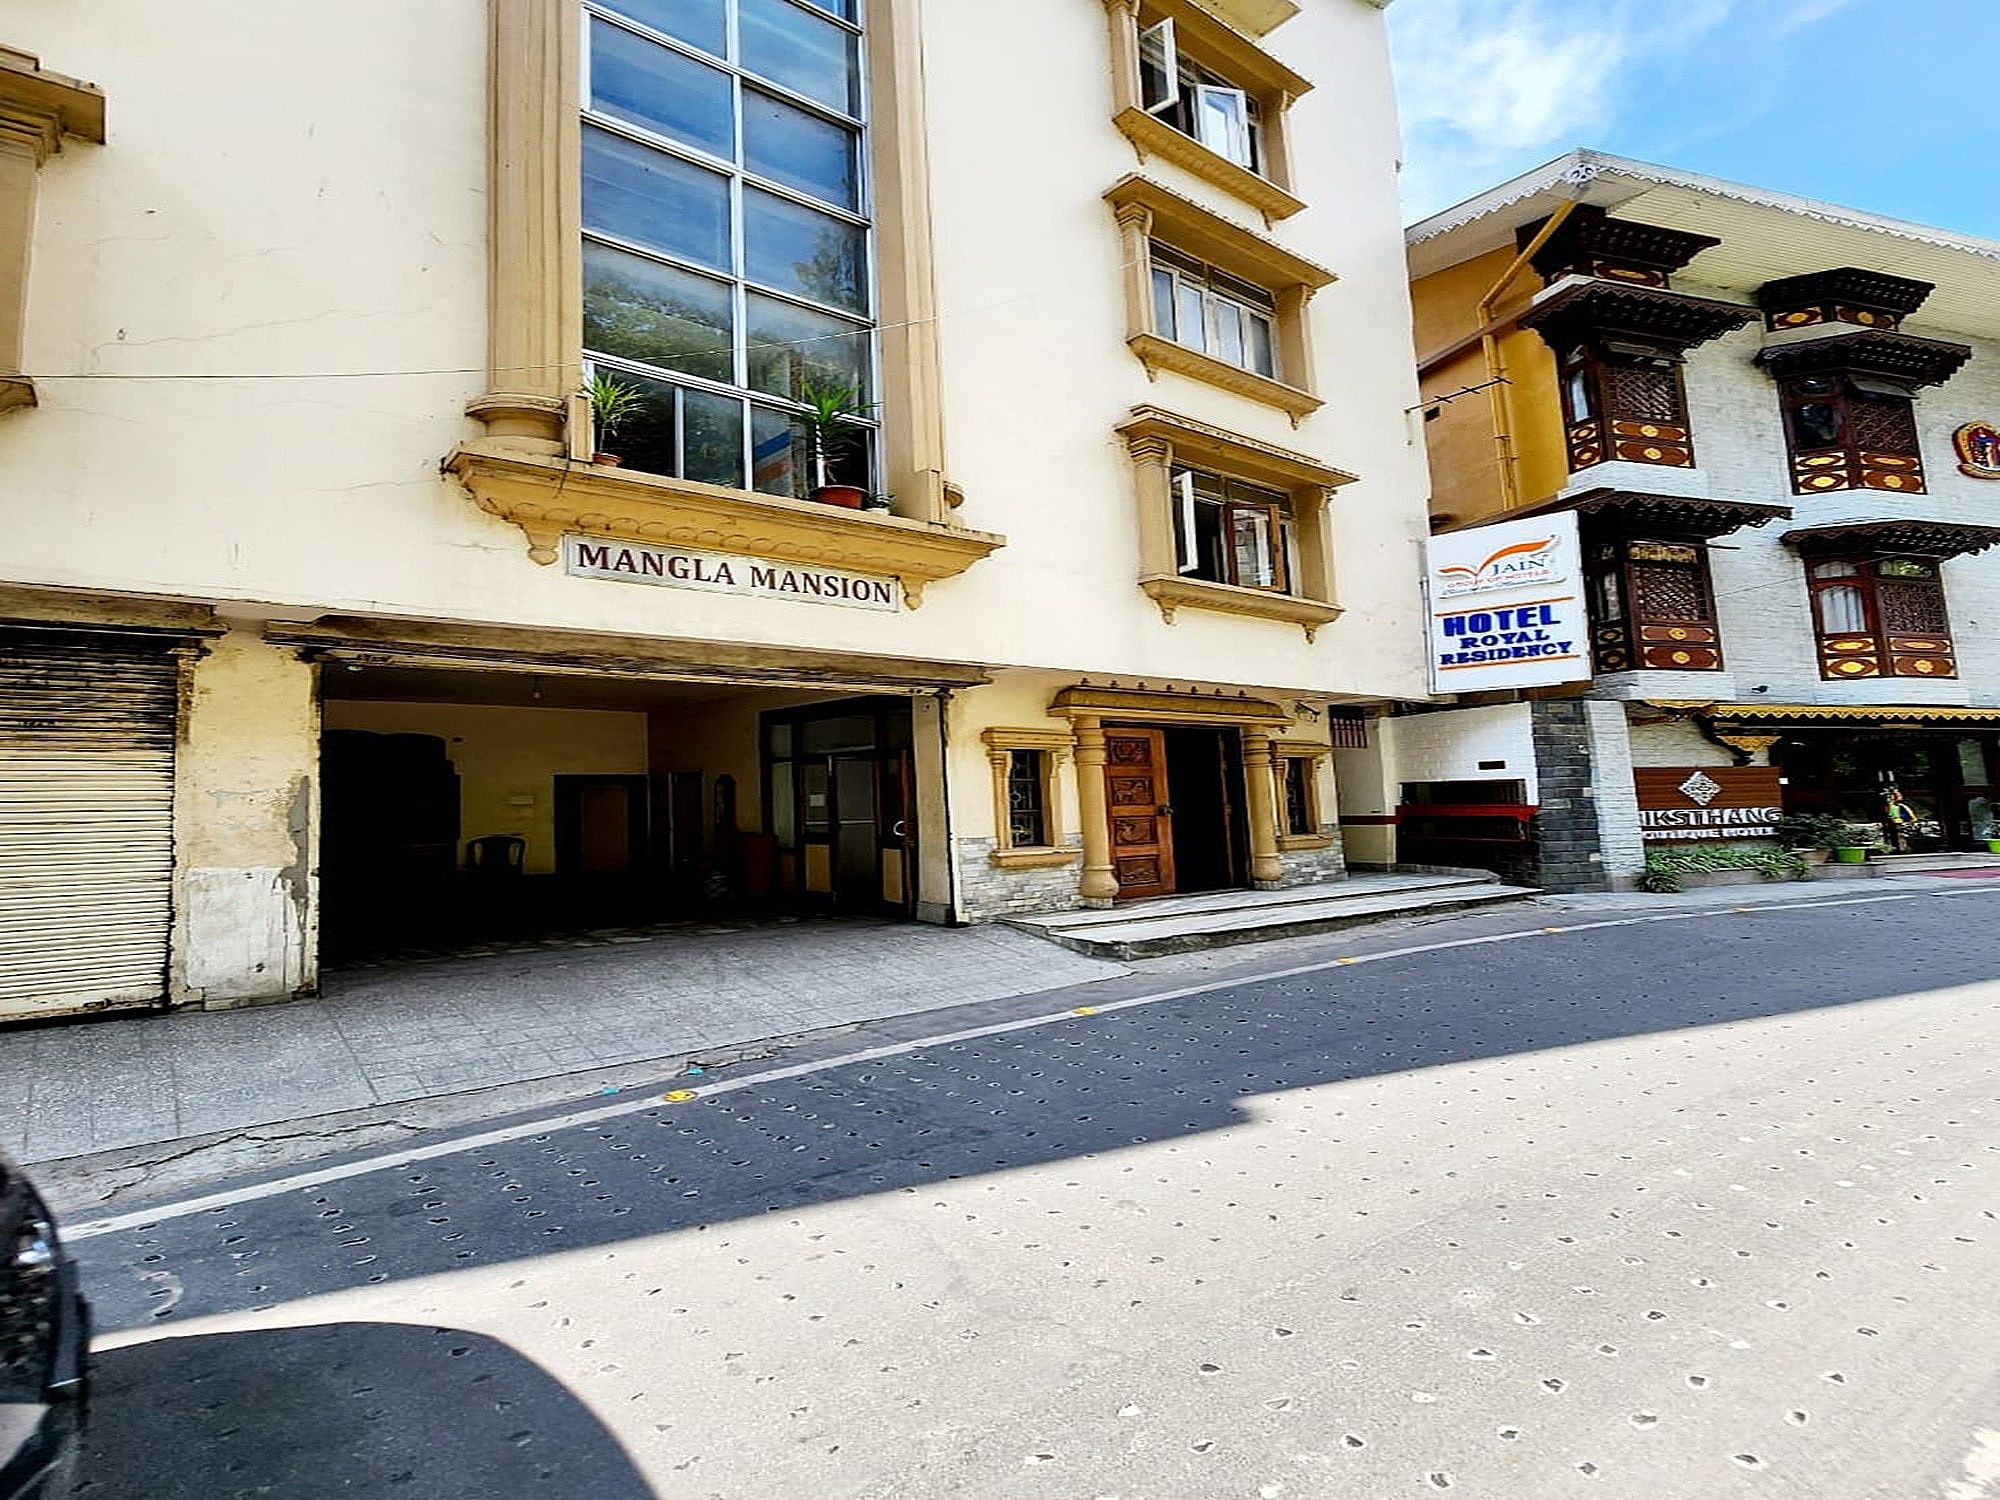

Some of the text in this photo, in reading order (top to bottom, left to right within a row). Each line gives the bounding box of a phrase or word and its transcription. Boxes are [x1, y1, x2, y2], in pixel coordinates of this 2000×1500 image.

[576, 543, 892, 604] MANGLA MANSION
[1492, 558, 1546, 576] JAIN
[1443, 604, 1562, 637] HOTEL
[1459, 629, 1550, 649] ROYAL
[1439, 640, 1573, 665] RESIDENCY
[1640, 807, 1783, 827] IKSTHANG
